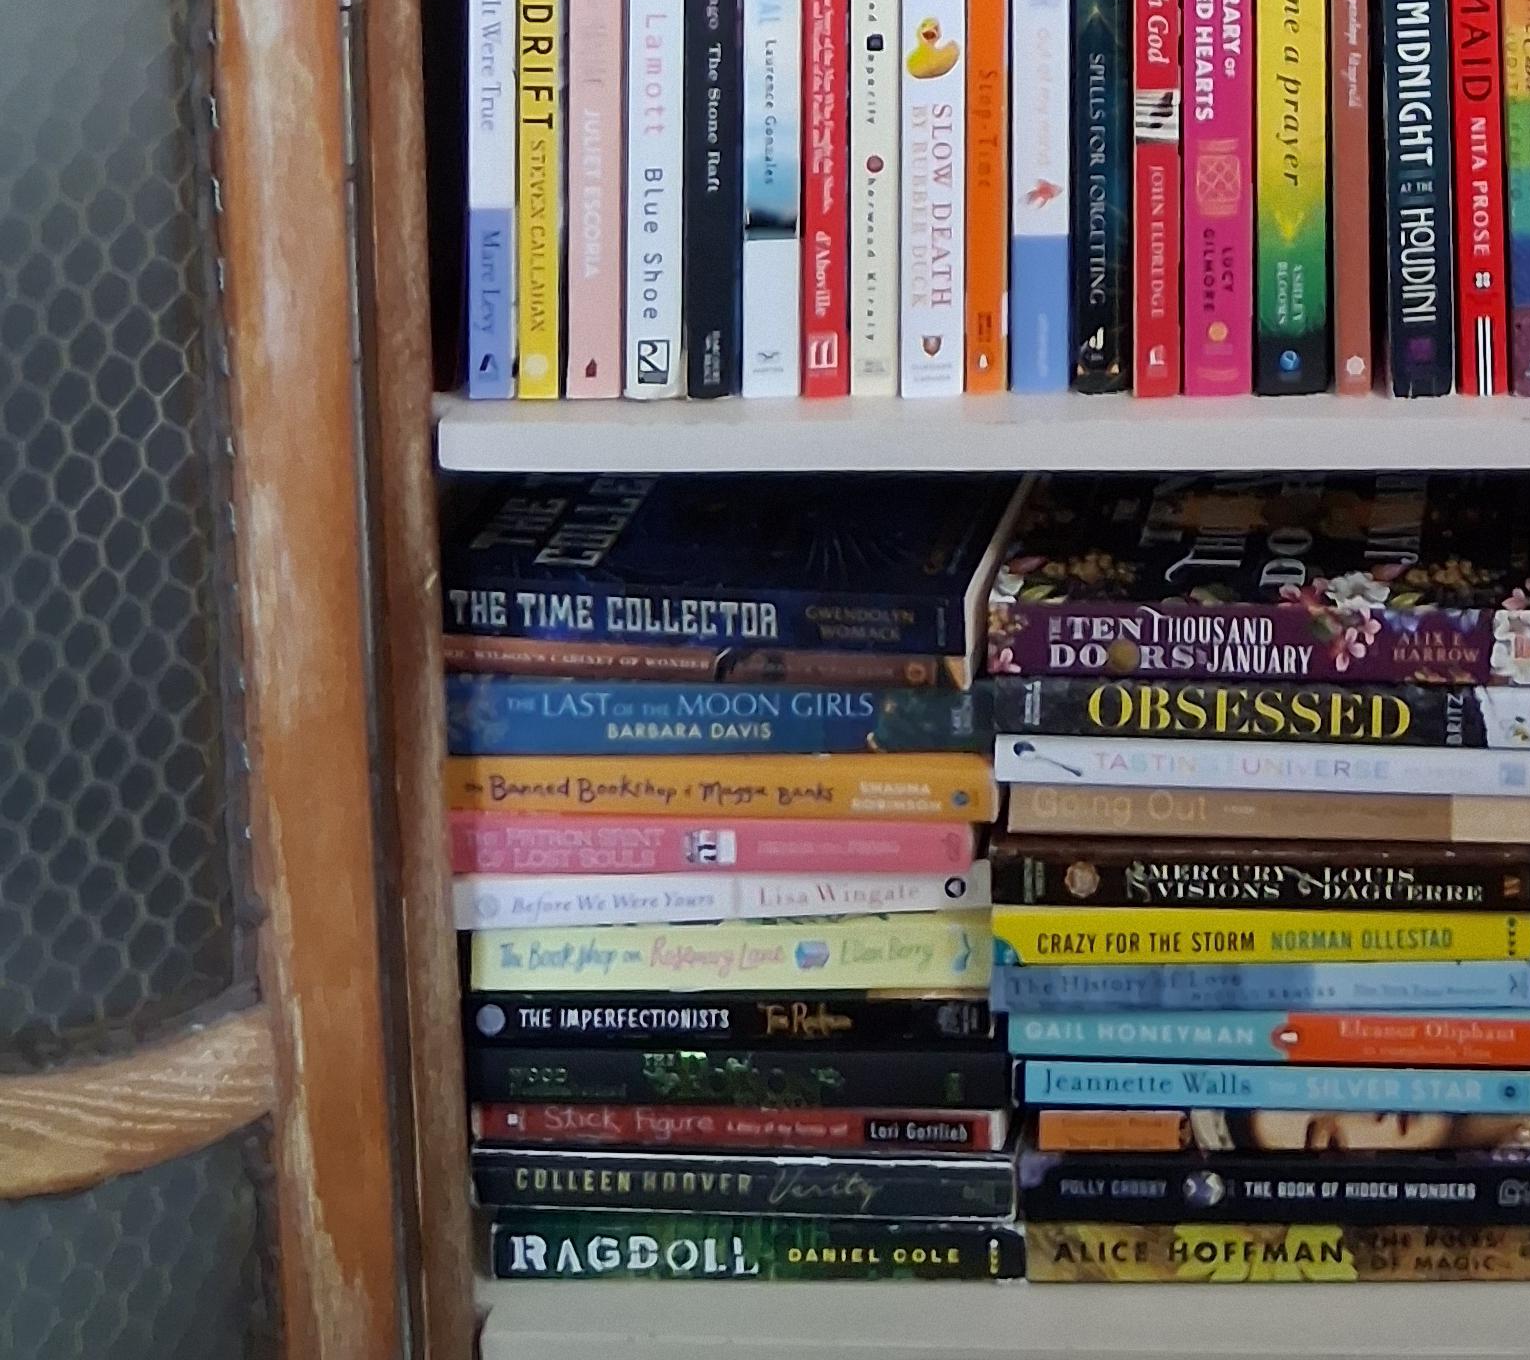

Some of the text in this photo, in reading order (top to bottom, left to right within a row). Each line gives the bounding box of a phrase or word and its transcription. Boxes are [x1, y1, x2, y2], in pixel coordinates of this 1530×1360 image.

[1148, 2, 1169, 64] God
[1285, 46, 1298, 60] a
[1194, 24, 1214, 121] HEARTS
[1396, 0, 1434, 168] MIDNIGHT
[1275, 72, 1300, 188] prayer
[1469, 116, 1490, 256] NITA PROSE
[642, 167, 664, 321] Blue Shoe
[449, 590, 778, 637] THE TIME COLLECTOR
[608, 723, 771, 739] BARBARA DAVIS
[1088, 684, 1411, 740] OBSESSED
[1037, 931, 1255, 953] CRAZY FOR THE STORM
[519, 1009, 729, 1029] THE IMPERFECTIONISTS
[1042, 1070, 1252, 1096] Jeannette Walls
[510, 1235, 959, 1274] RAGDOLL DANIEL COLE
